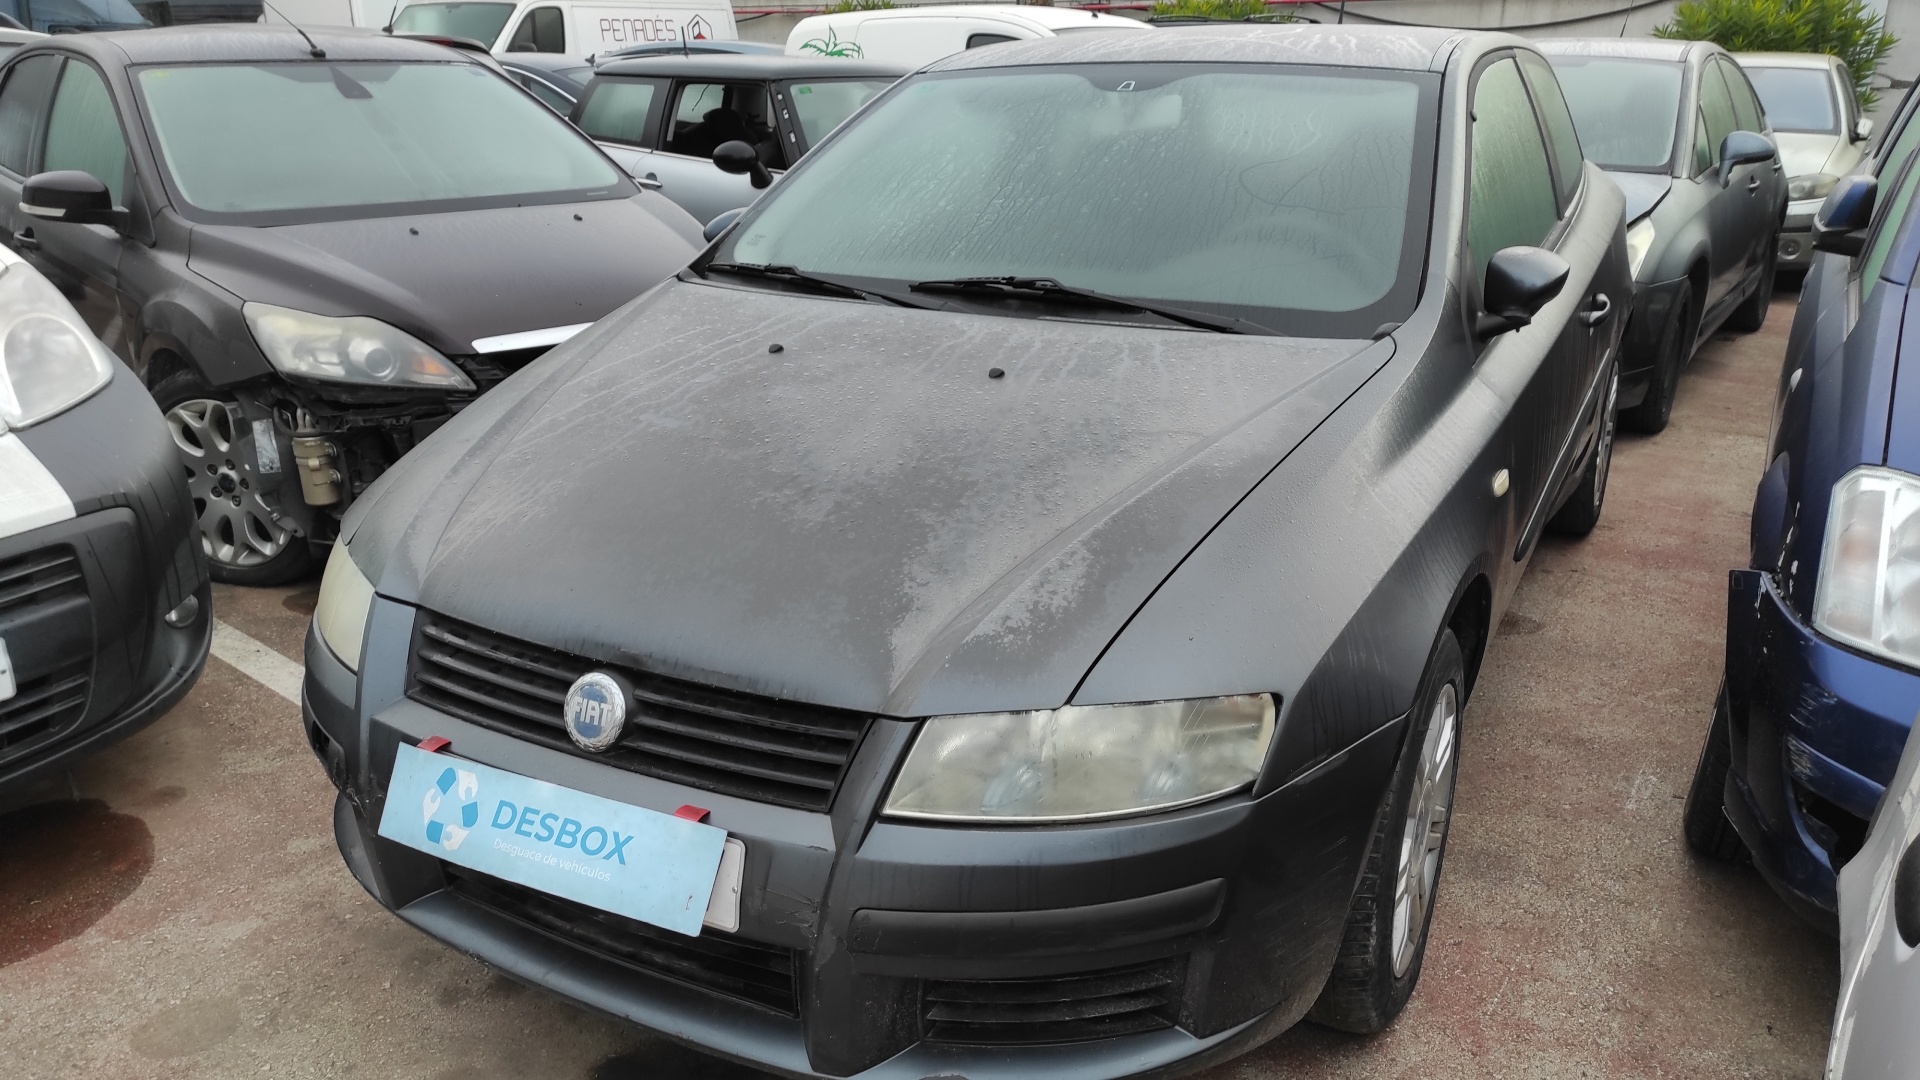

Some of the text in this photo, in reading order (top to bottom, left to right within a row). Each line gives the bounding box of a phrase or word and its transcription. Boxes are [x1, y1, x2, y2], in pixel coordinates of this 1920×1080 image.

[600, 14, 676, 41] PENADÉS
[572, 696, 613, 728] FIAT
[491, 800, 634, 865] DESBOX
[493, 838, 611, 882] Desguace de vehículos
